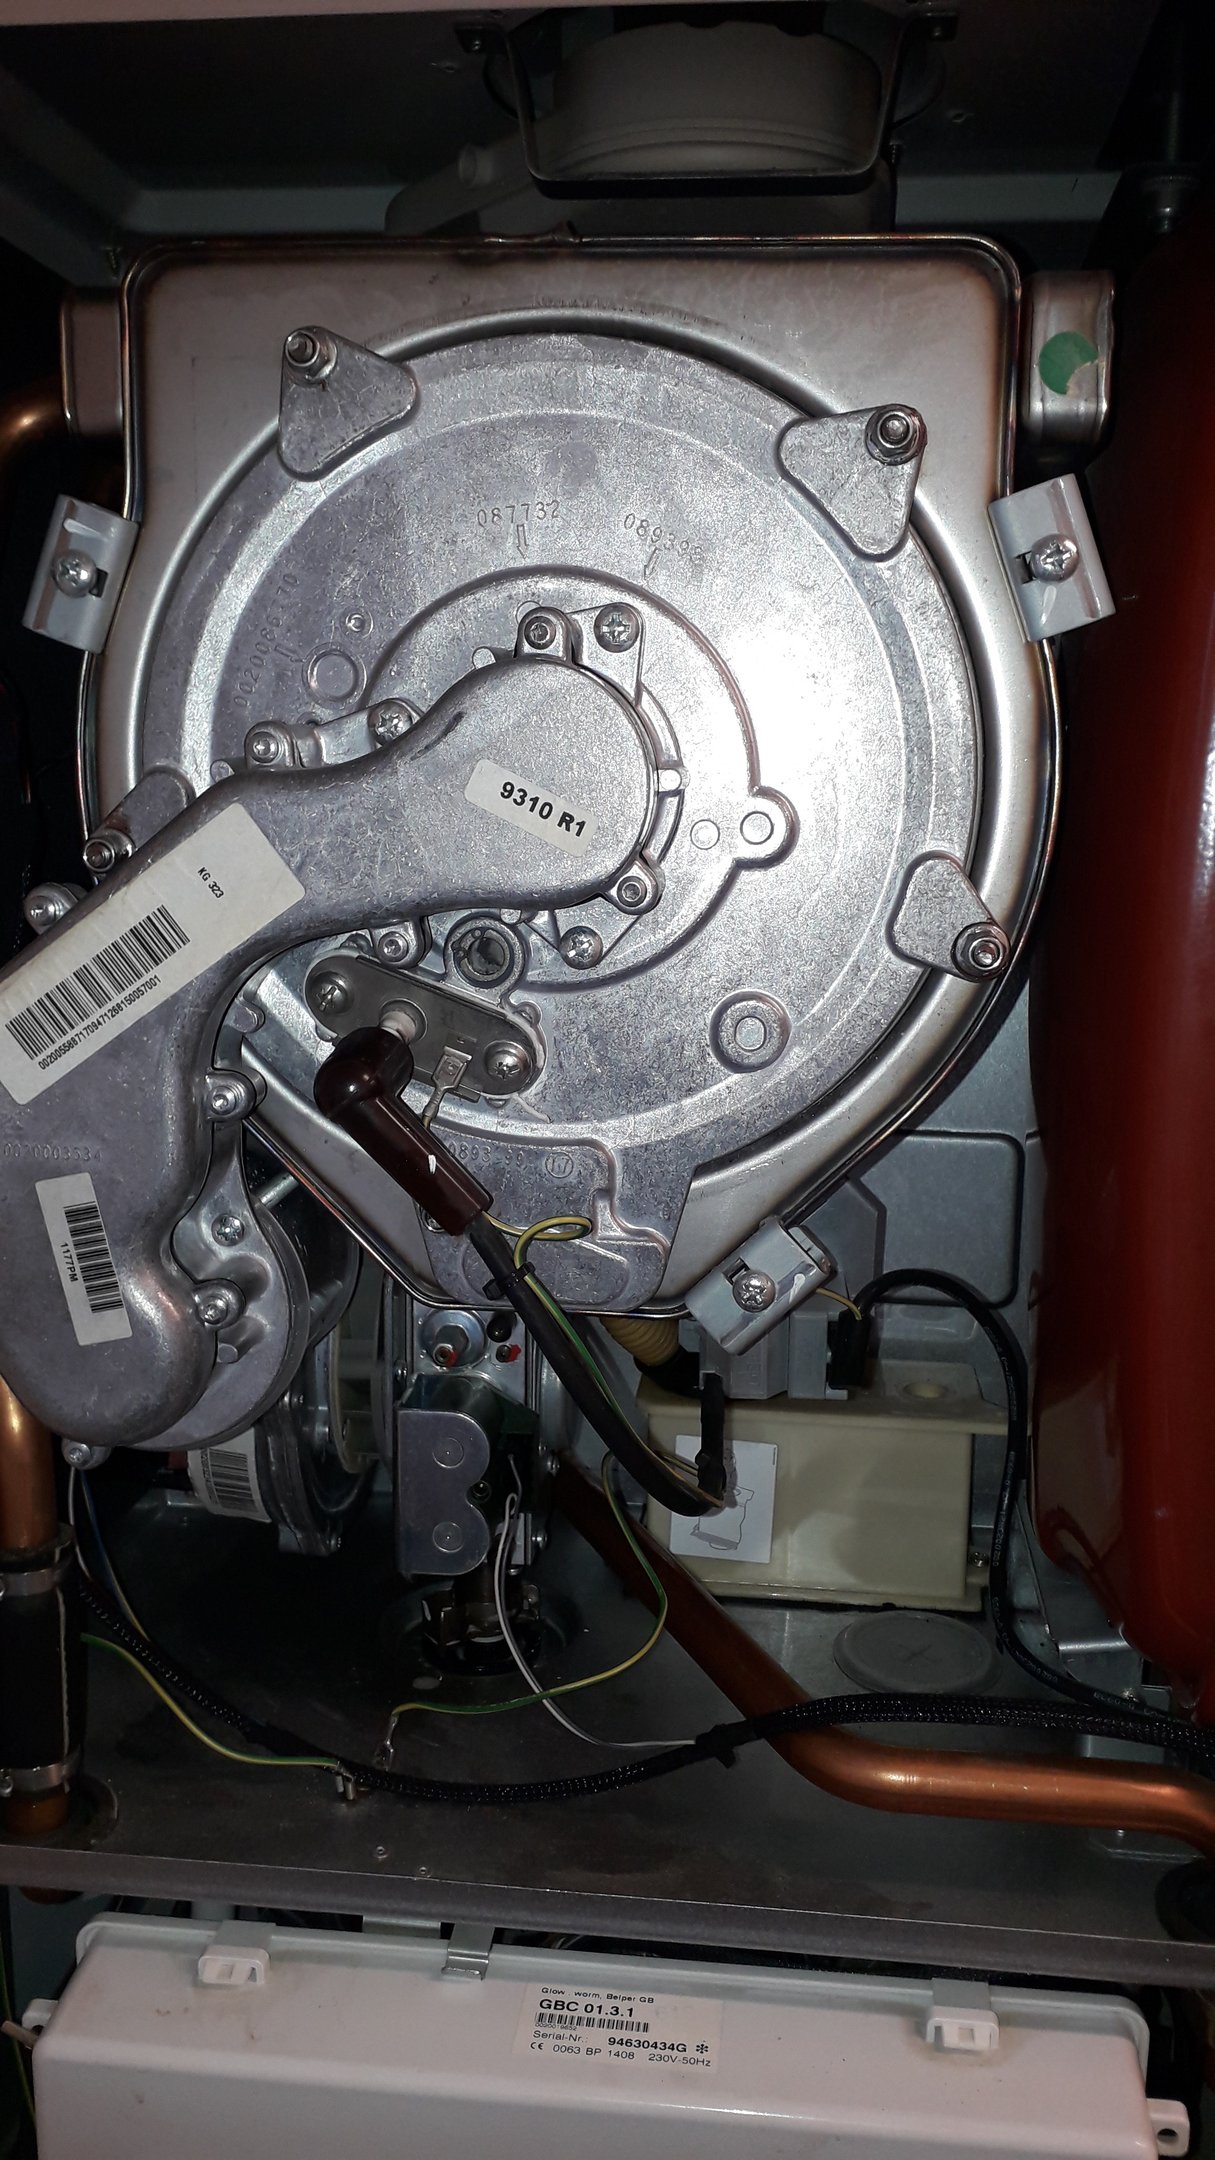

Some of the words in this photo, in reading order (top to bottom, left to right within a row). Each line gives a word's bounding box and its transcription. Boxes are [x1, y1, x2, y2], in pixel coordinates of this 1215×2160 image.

[500, 781, 553, 820] 9310
[557, 811, 586, 837] R1
[197, 866, 211, 882] KG
[208, 880, 224, 899] 323
[60, 1242, 79, 1282] 1177PM
[541, 1987, 565, 1995] Glow
[606, 1993, 636, 2002] Belper
[639, 1996, 654, 2004] GB
[539, 1998, 579, 2012] GBC
[584, 2003, 633, 2018] 01.3.1
[552, 2044, 581, 2054] 0063
[586, 2047, 602, 2056] BP
[608, 2050, 635, 2060] 1408
[648, 2053, 711, 2067] 230V-50Hz
[608, 2036, 687, 2053] 94630434G
